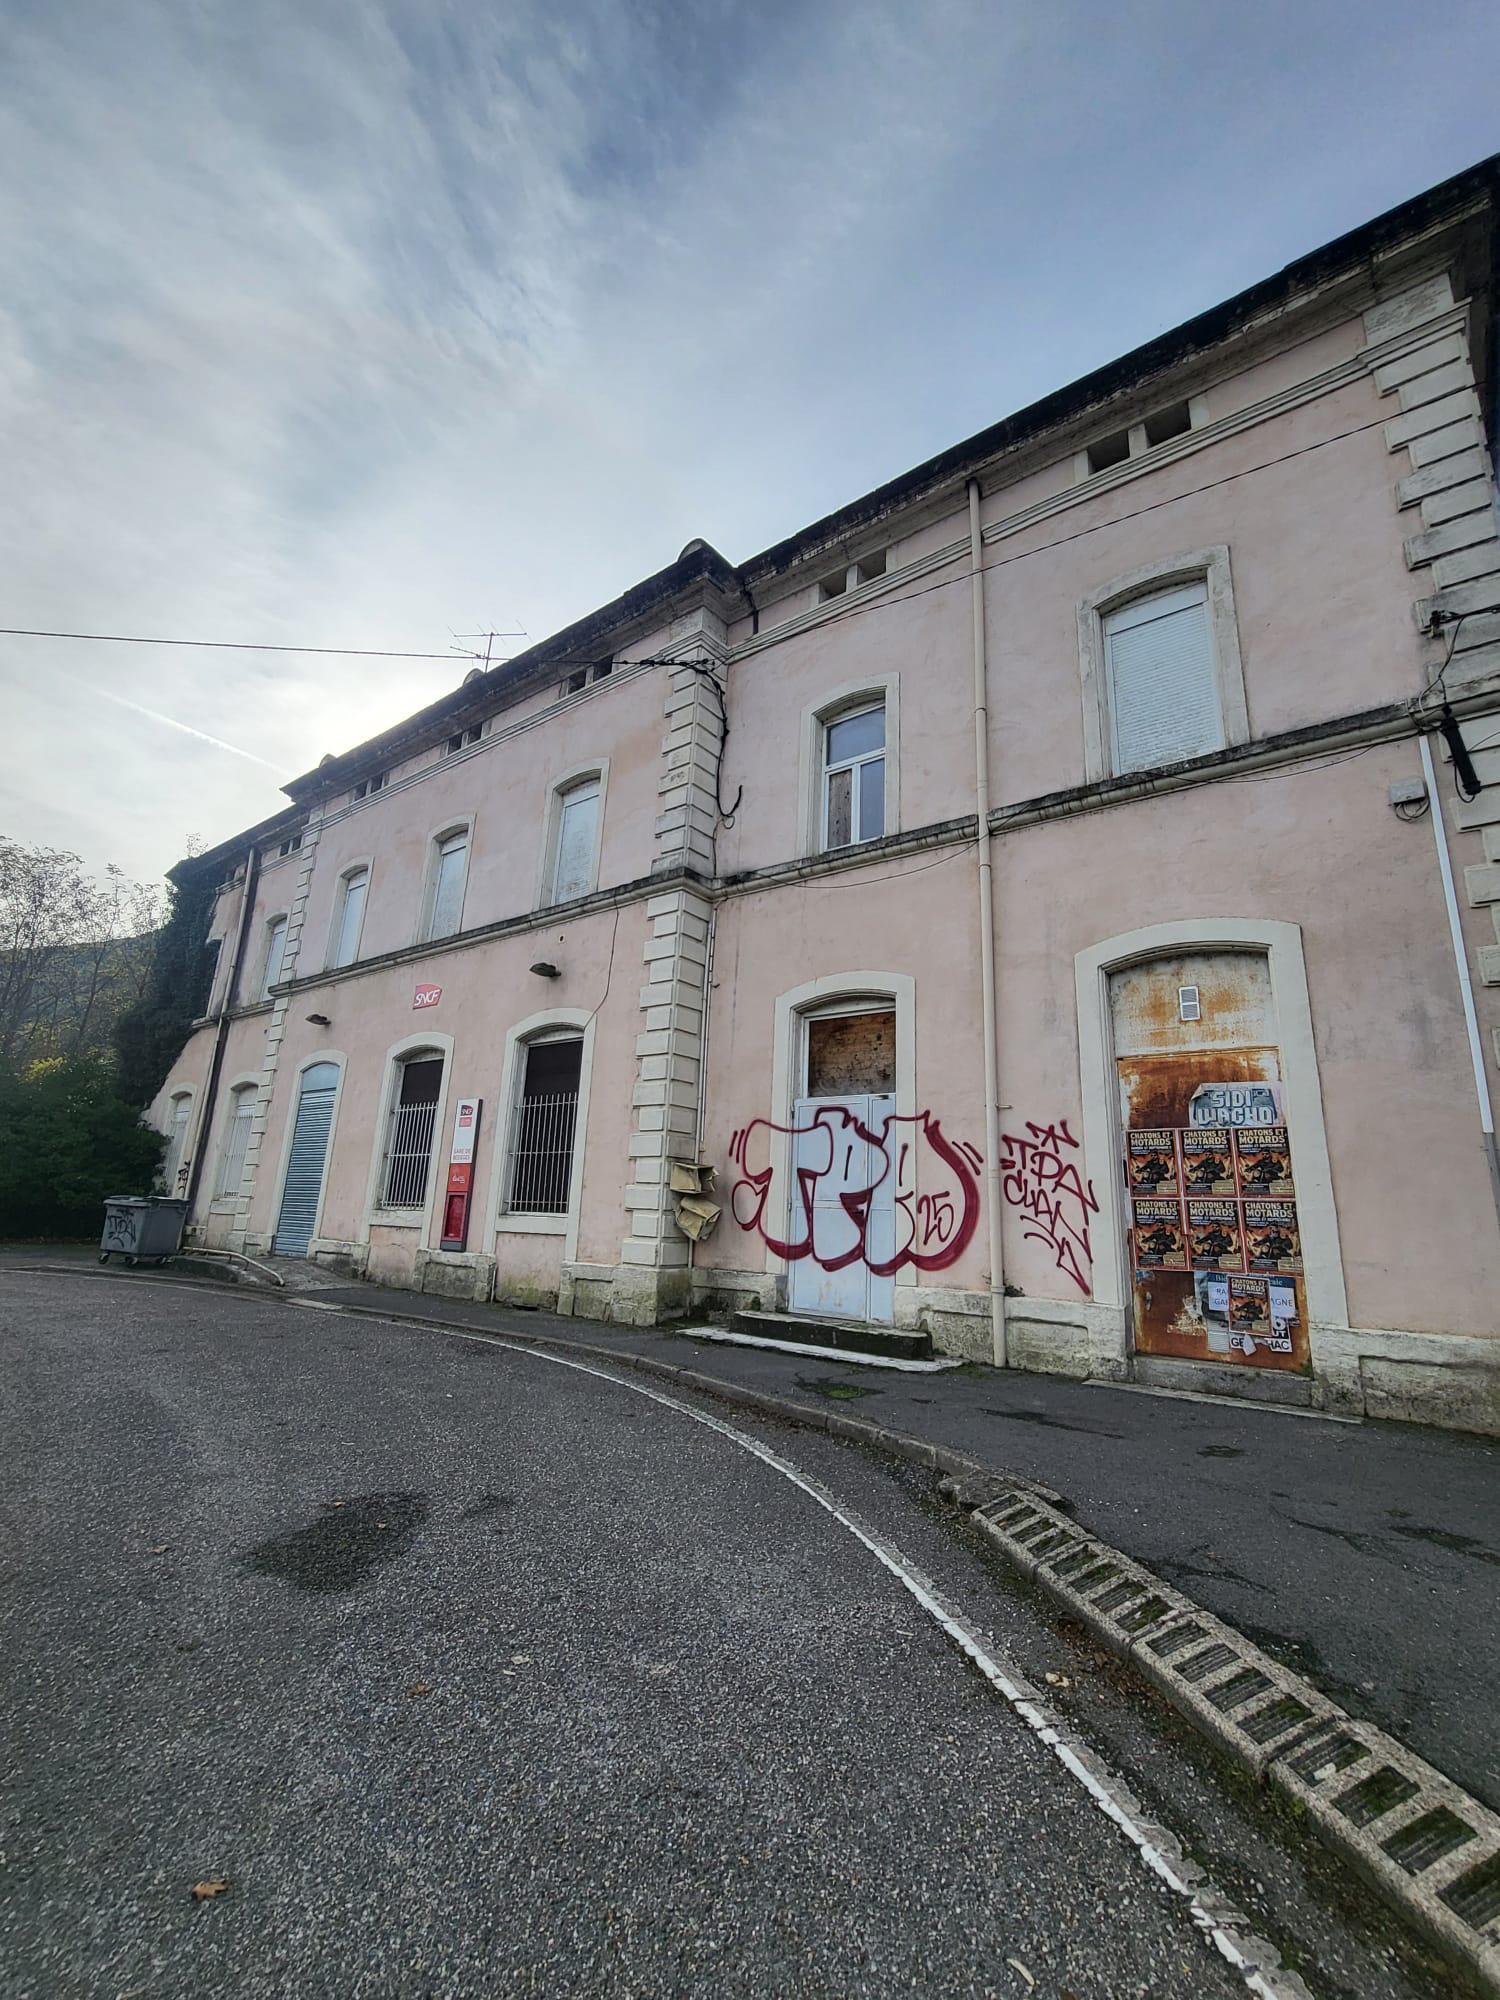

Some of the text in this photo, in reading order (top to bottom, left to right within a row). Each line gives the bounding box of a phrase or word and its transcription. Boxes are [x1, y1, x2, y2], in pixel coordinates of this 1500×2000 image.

[414, 989, 441, 1006] SNCF
[1211, 1089, 1252, 1107] SIDI
[1197, 1106, 1273, 1126] WACHO
[1130, 1131, 1171, 1140] CHATONS ET
[1183, 1130, 1217, 1138] CHATONS
[1238, 1128, 1284, 1136] CHATONS ET
[1131, 1138, 1171, 1146] MOTARDS
[1184, 1136, 1228, 1145] MOTARDS
[1239, 1135, 1286, 1145] MOTARDS
[1135, 1200, 1168, 1209] CHATONS
[1189, 1201, 1223, 1209] CHATONS
[1245, 1202, 1281, 1210] CHATONS
[1136, 1207, 1178, 1216] MOTARDS
[1190, 1208, 1235, 1217] MOTARDS
[1246, 1209, 1294, 1218] MOTARDS
